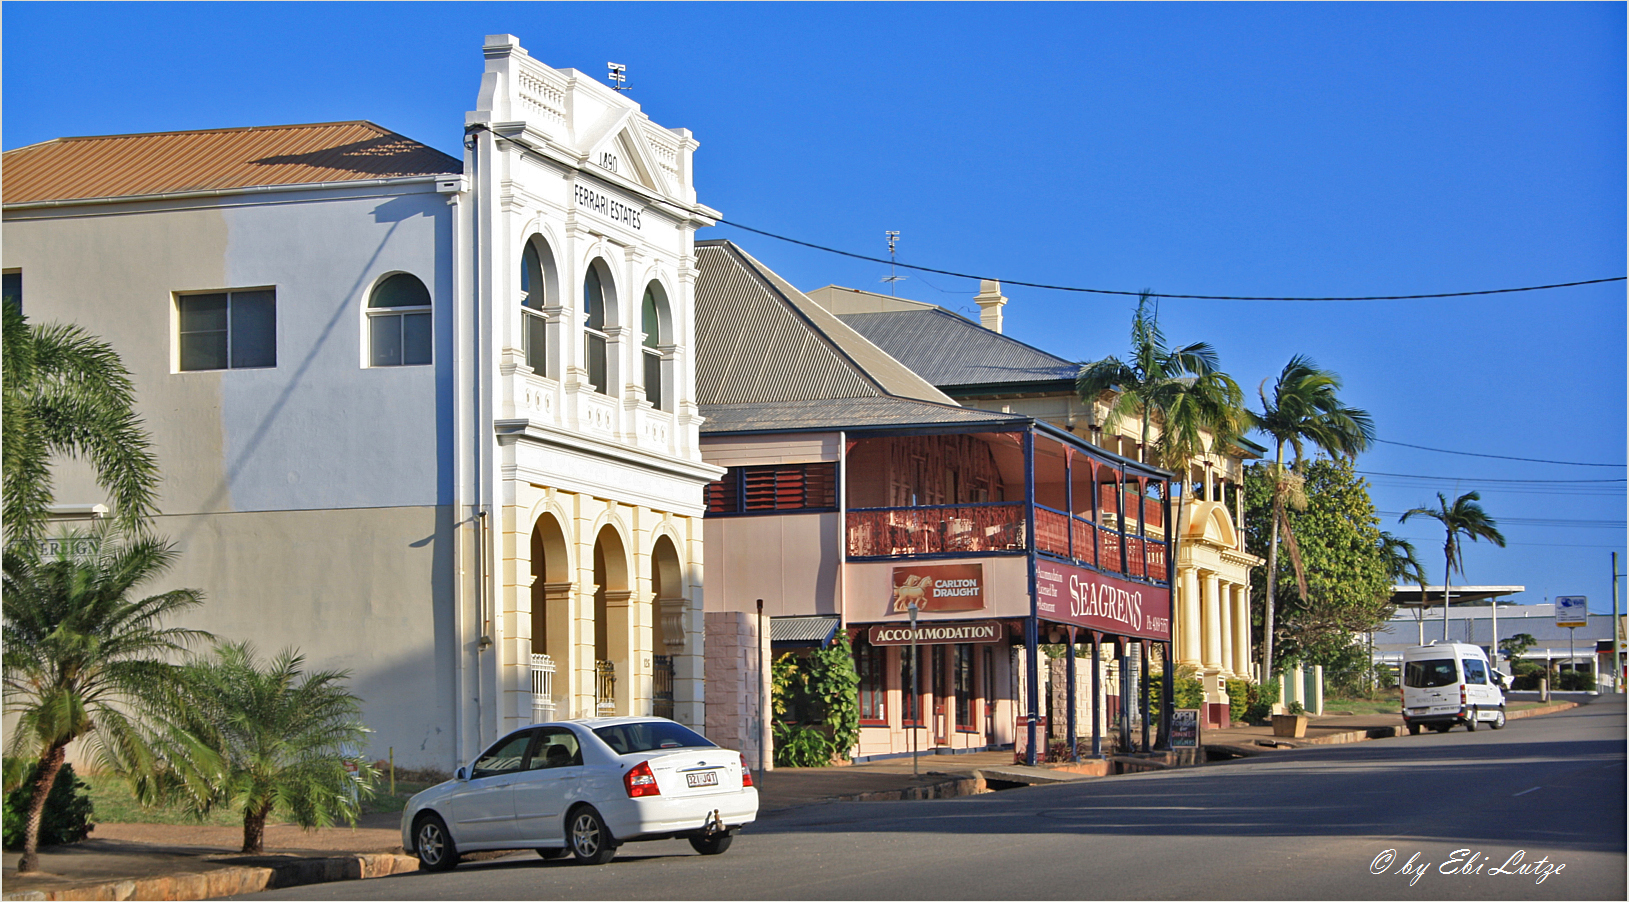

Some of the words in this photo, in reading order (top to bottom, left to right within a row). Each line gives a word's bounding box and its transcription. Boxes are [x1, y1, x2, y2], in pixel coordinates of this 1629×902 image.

[599, 152, 617, 172] 1890
[575, 184, 608, 216] FERRARI
[611, 200, 641, 230] ESTATES
[935, 579, 977, 588] CARLTON
[932, 587, 980, 598] DRAUGHT
[1069, 574, 1142, 631] SEAGRENS
[876, 626, 995, 642] ACCOMMODATION
[1172, 711, 1195, 720] OPEN
[688, 775, 699, 784] 321
